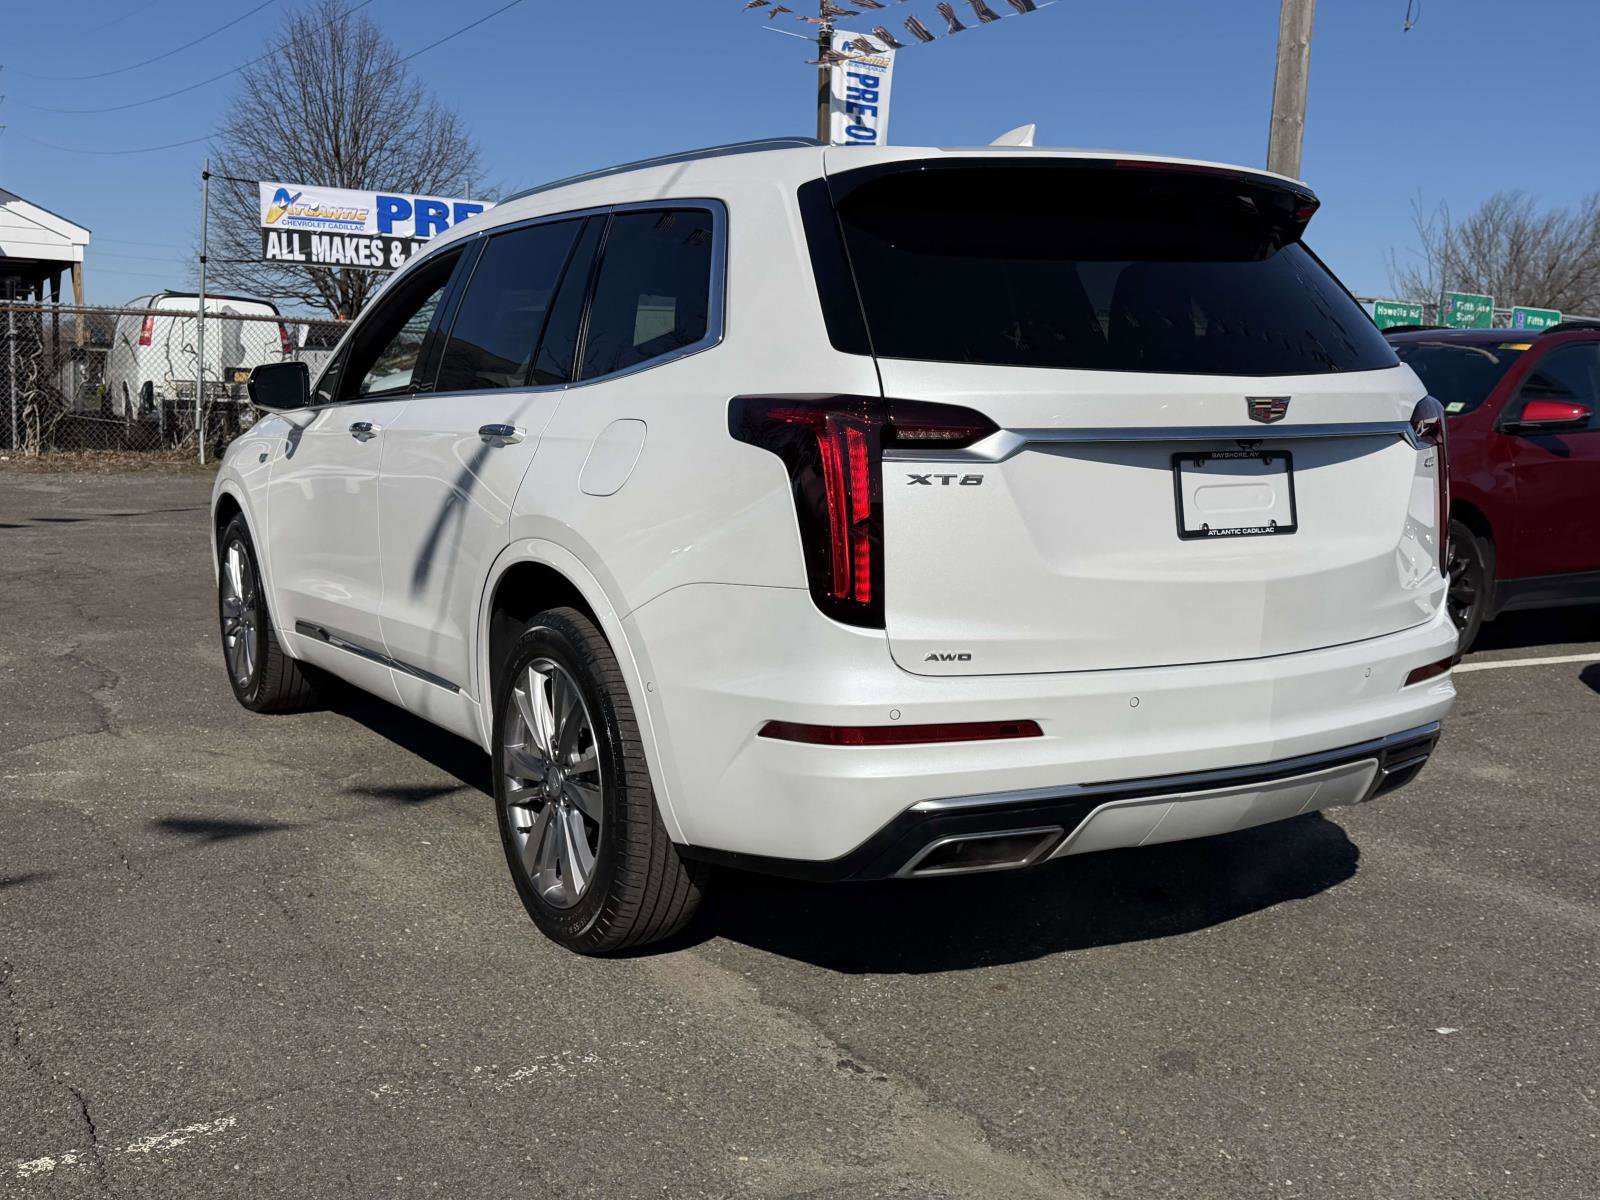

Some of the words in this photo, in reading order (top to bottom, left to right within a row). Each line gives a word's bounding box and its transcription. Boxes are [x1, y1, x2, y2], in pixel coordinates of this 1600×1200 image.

[845, 71, 880, 146] PRE-O
[281, 219, 326, 229] CHEVROLET
[328, 222, 365, 232] CADILLAC
[266, 231, 306, 261] ALL
[311, 235, 385, 267] MAKES
[389, 240, 405, 268] &
[905, 473, 984, 486] XT6
[1208, 528, 1241, 536] ATLANTIC
[1242, 526, 1275, 534] CADILLAC
[924, 653, 972, 662] AWD
